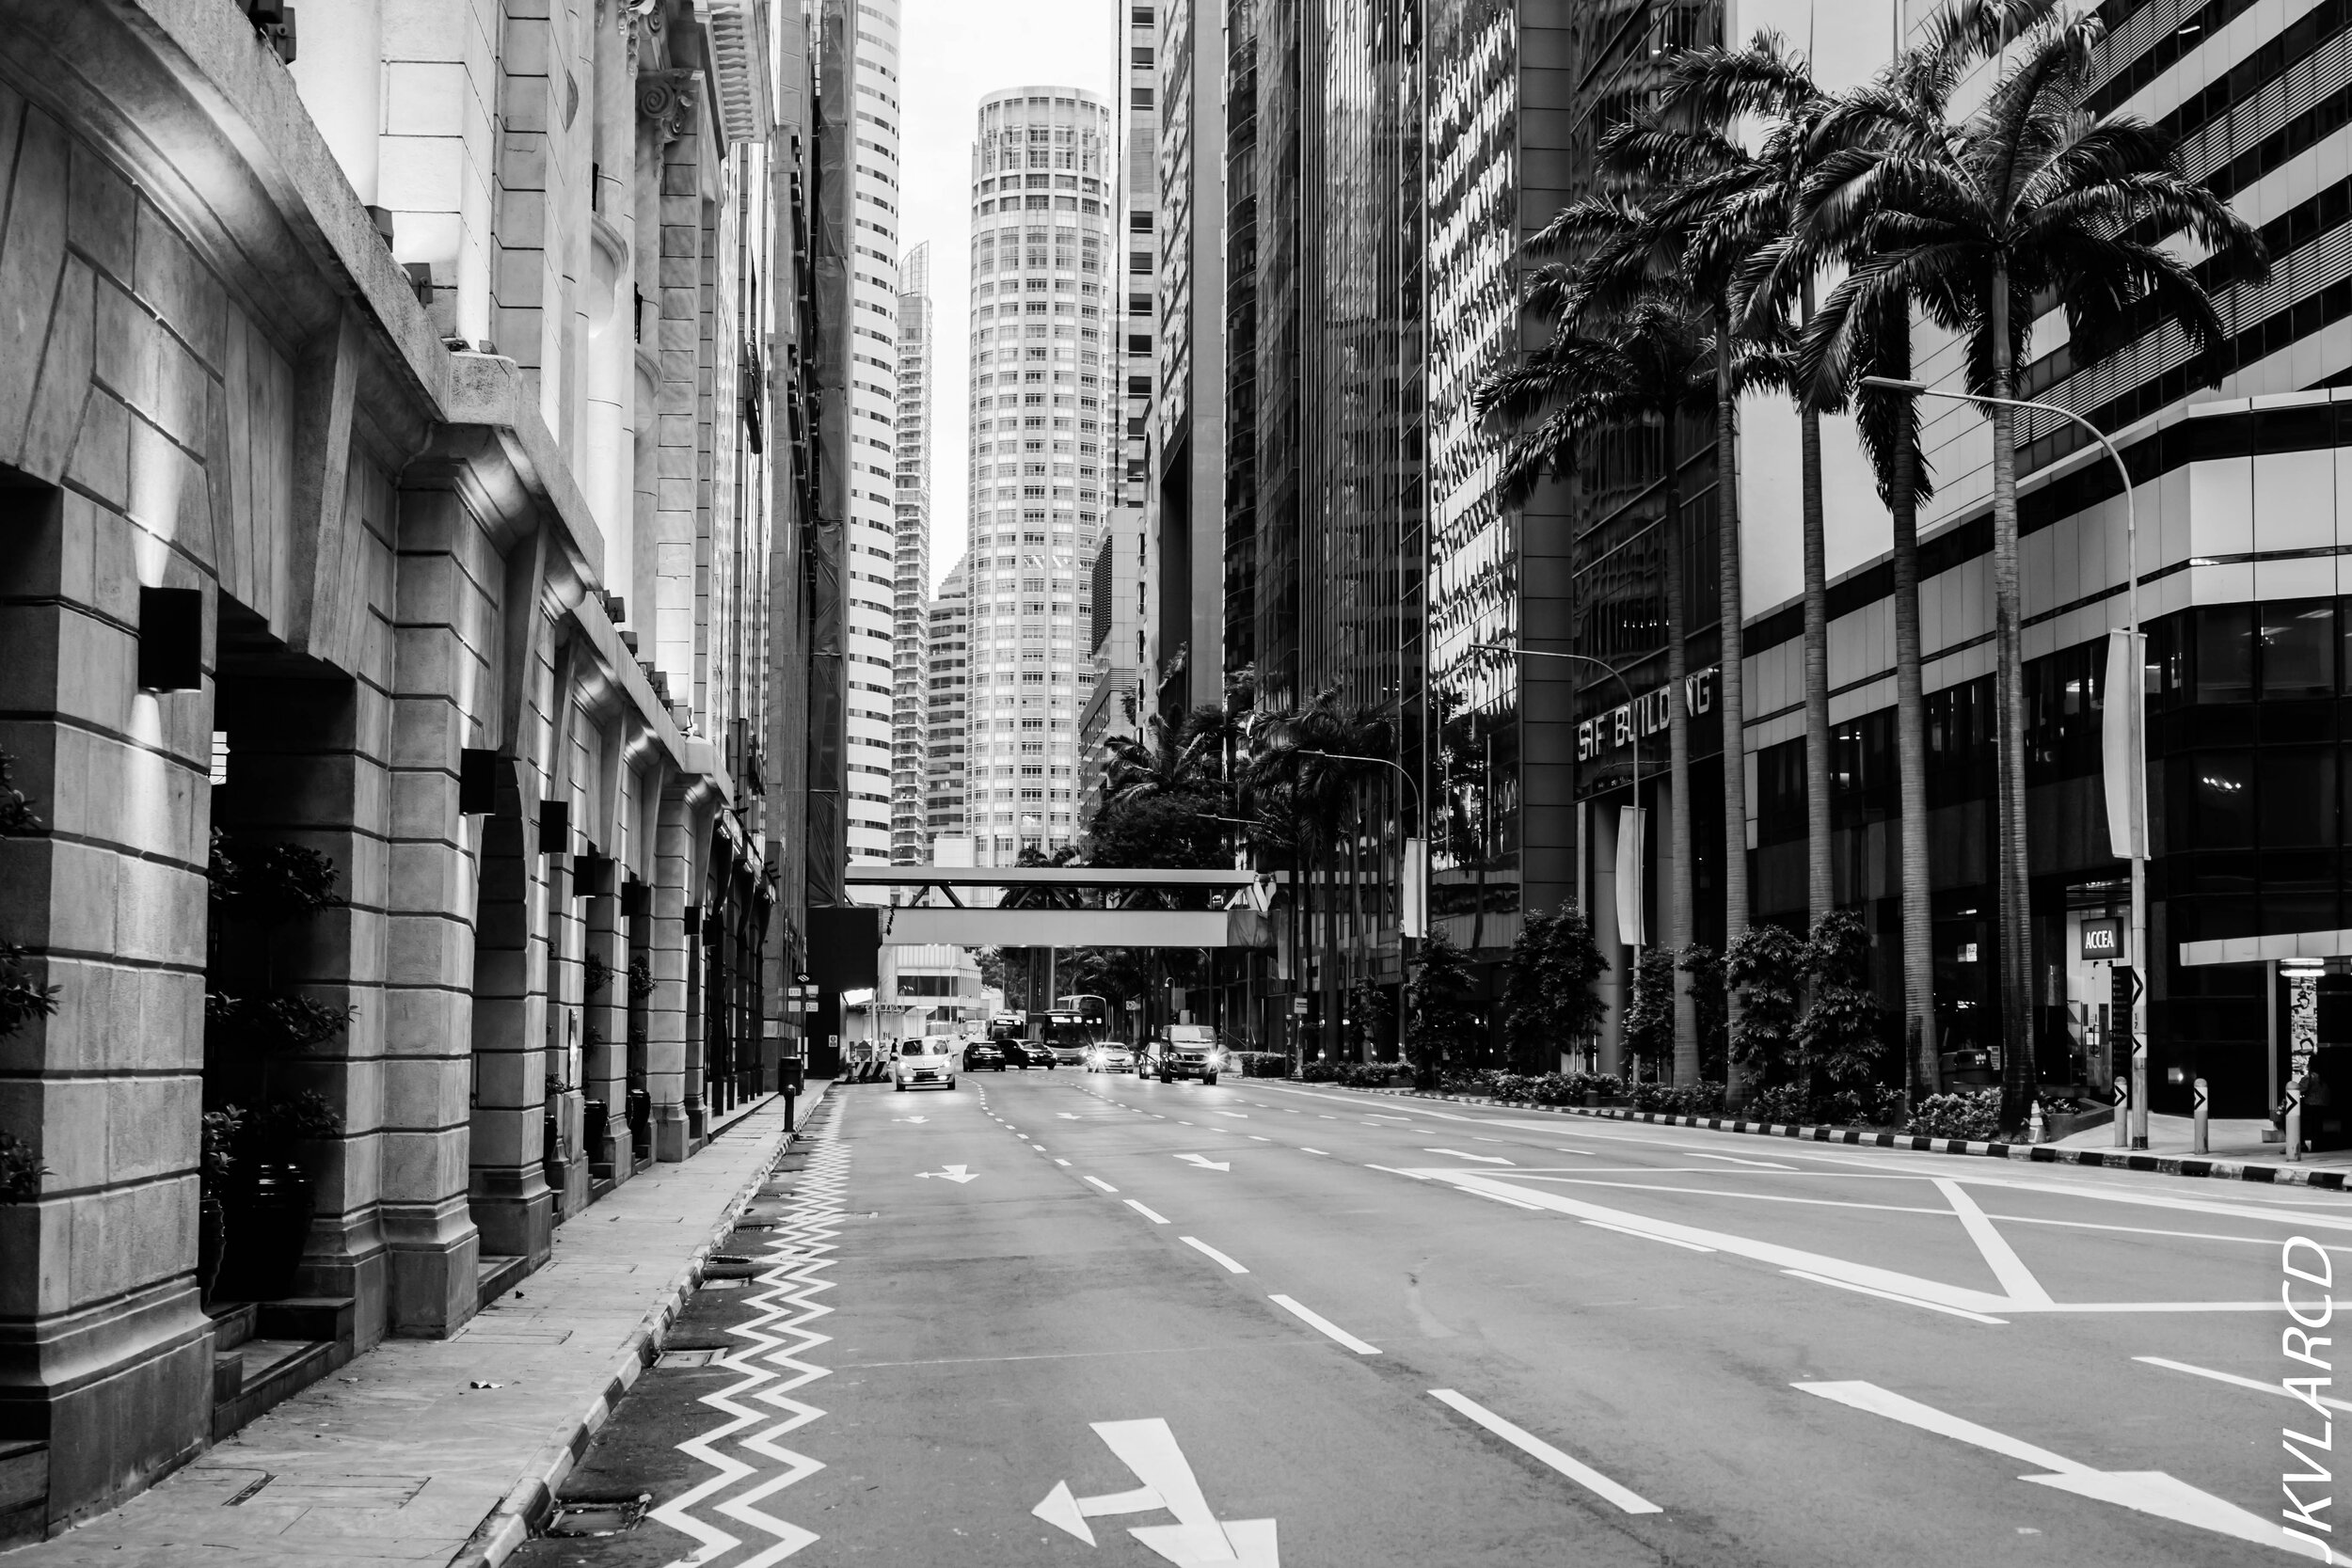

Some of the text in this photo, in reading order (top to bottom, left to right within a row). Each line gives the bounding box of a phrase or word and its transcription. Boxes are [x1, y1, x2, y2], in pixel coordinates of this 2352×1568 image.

[1578, 667, 1711, 762] SIF BUILDNG
[2085, 930, 2114, 949] ACCEA
